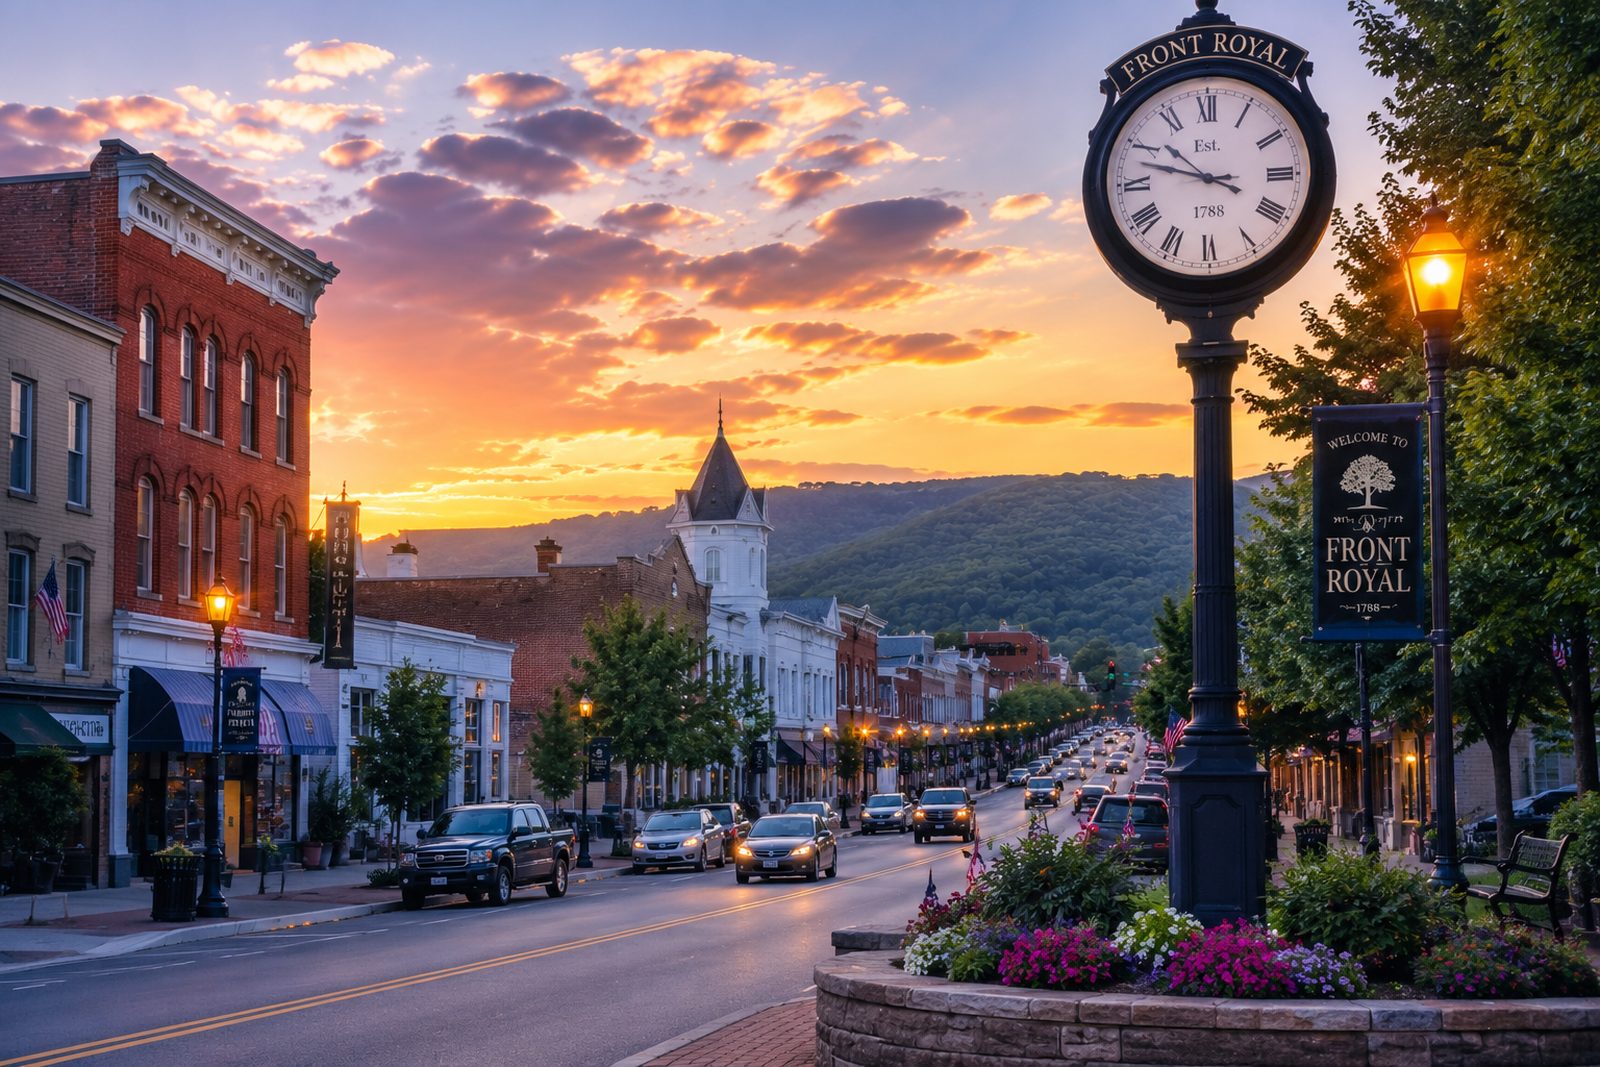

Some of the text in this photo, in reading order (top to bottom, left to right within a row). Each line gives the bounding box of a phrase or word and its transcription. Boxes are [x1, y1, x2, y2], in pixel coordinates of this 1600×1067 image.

[1121, 32, 1290, 82] FRONT ROYAL
[1196, 95, 1218, 123] XII
[1158, 106, 1184, 136] XI
[1132, 138, 1160, 159] X
[1193, 139, 1221, 153] Est.
[1256, 129, 1284, 150] II
[1123, 175, 1151, 192] IX
[1266, 166, 1294, 182] III
[1193, 204, 1225, 218] 1788
[1202, 234, 1218, 261] VI
[1327, 432, 1409, 450] WELCOME TO
[1325, 537, 1412, 563] FRONT
[1325, 568, 1412, 593] ROYAL
[1356, 603, 1380, 614] 1788
